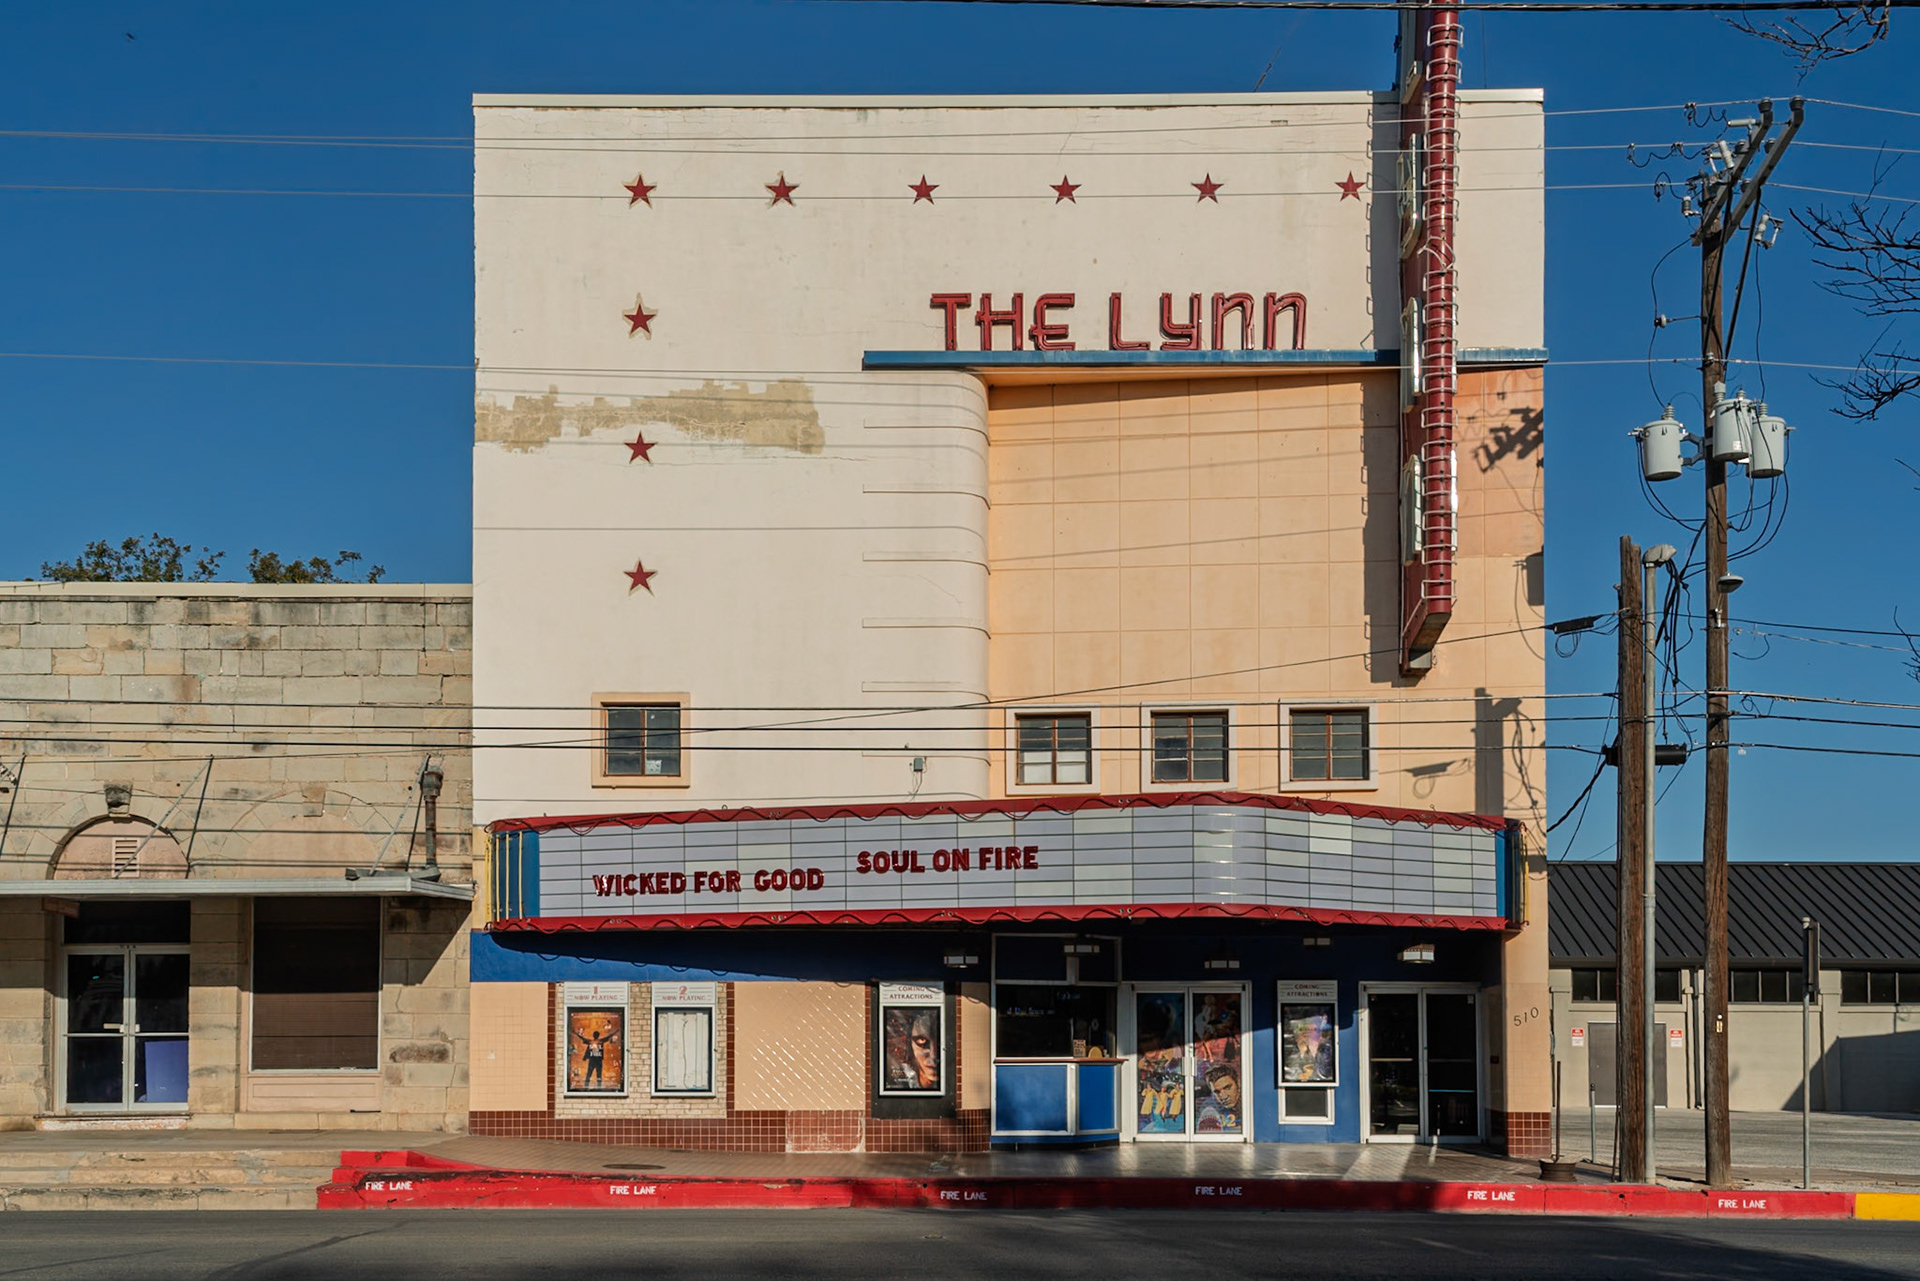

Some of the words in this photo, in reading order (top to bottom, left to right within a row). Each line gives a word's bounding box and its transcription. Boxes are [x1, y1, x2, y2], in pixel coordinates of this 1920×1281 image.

[931, 292, 1076, 351] THE
[856, 850, 925, 874] SOUL
[933, 848, 970, 872] ON
[979, 846, 1039, 871] FIRE
[593, 872, 686, 897] WICKED
[694, 870, 742, 893] FOR
[753, 868, 825, 892] GOOD
[1513, 1006, 1539, 1027] 510
[365, 1181, 386, 1190] FIRE
[389, 1181, 414, 1190] LANE
[610, 1185, 630, 1195] FIRE
[633, 1185, 657, 1195] LANE
[940, 1190, 960, 1200] FIRE
[964, 1191, 987, 1200] LANE
[1195, 1186, 1215, 1195] FIRE
[1219, 1186, 1243, 1196] LANE
[1467, 1190, 1488, 1200] FIRE
[1491, 1191, 1515, 1201] LANE
[1718, 1199, 1738, 1208] FIRE
[1743, 1199, 1767, 1209] LANE
